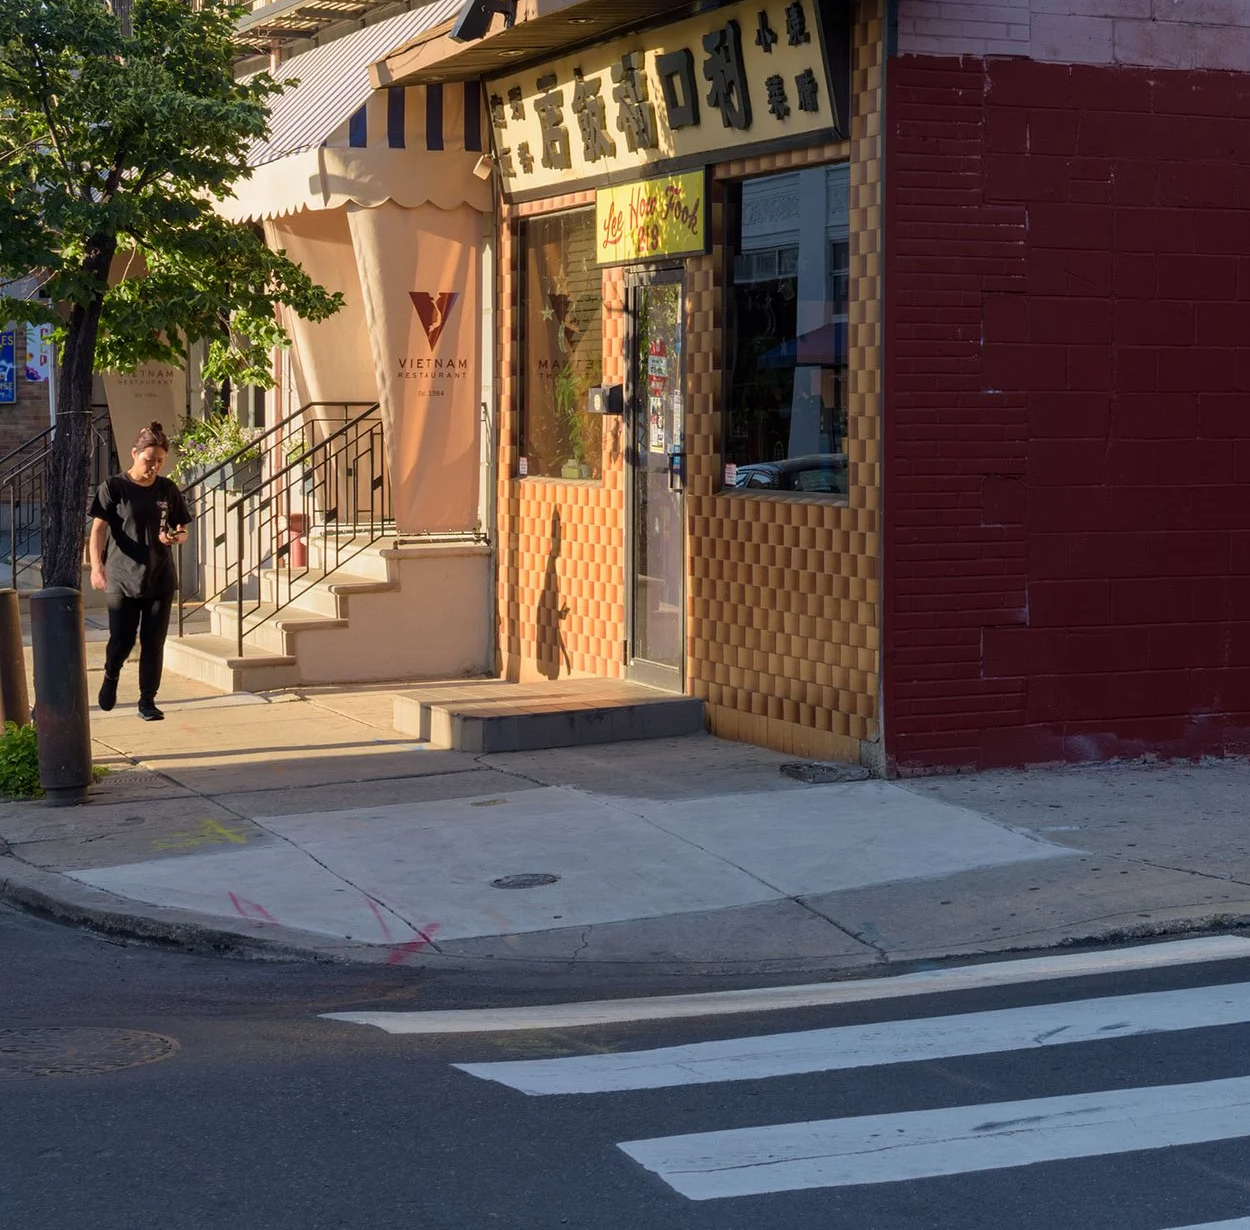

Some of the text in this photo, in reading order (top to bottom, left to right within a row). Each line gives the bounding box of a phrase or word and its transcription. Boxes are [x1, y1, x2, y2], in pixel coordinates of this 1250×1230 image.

[602, 185, 701, 249] Lee How Fook
[397, 358, 468, 369] VIETNAM
